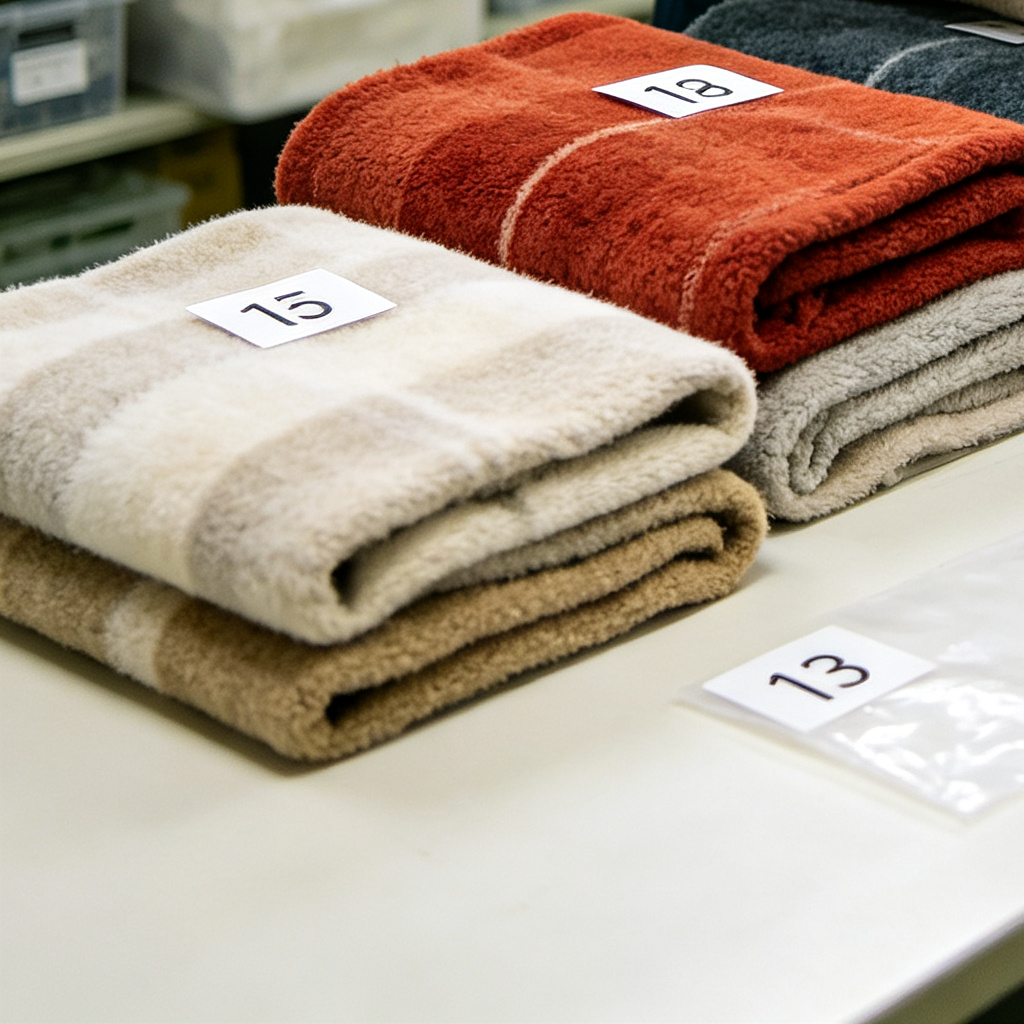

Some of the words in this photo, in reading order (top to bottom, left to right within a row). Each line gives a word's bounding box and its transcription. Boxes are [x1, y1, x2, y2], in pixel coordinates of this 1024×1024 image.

[644, 78, 734, 105] 18
[240, 290, 333, 327] 15
[769, 654, 870, 701] 13
